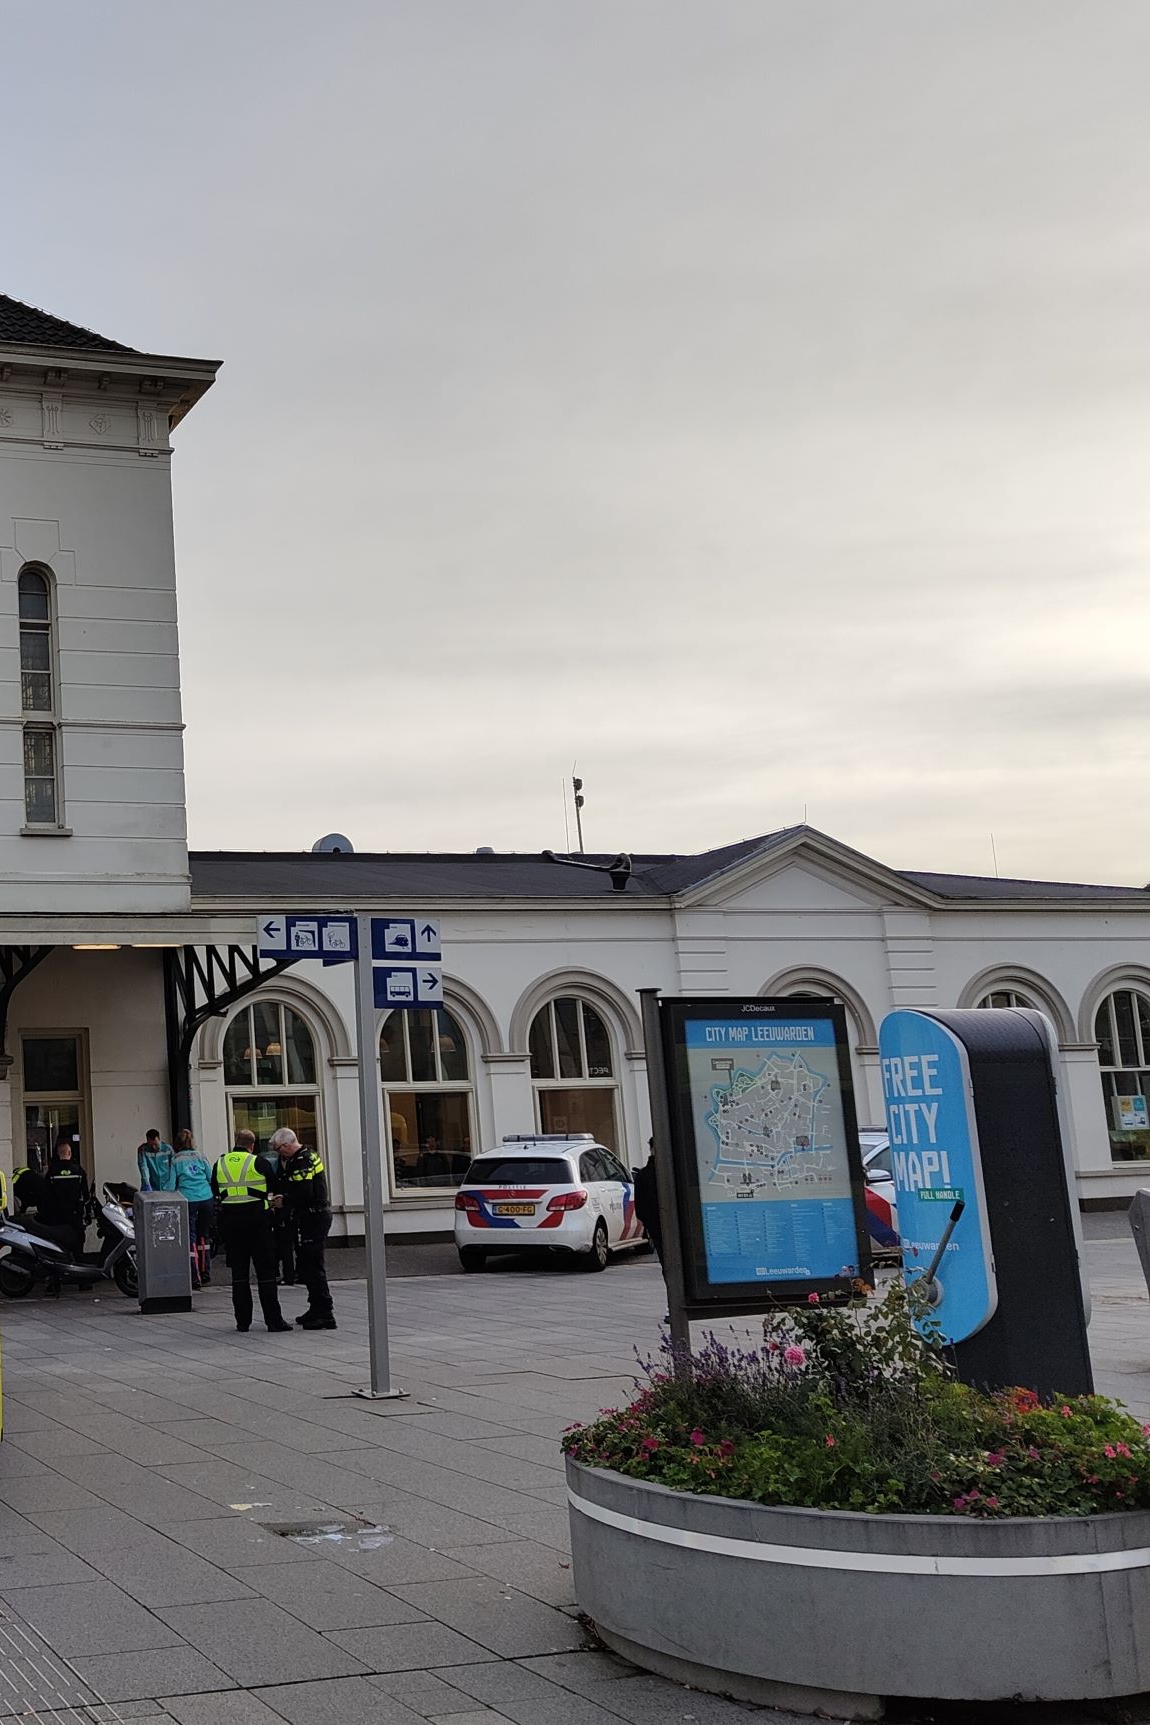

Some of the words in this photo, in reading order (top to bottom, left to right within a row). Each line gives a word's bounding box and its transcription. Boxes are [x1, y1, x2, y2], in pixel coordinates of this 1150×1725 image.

[741, 1004, 775, 1013] JCDecaux
[705, 1027, 726, 1042] CITY
[728, 1026, 749, 1042] MAP
[751, 1026, 815, 1042] LEEUWARDEN
[881, 1054, 943, 1098] FREE
[889, 1102, 939, 1145] CITY
[893, 1150, 951, 1192] MAP!
[920, 1190, 935, 1200] PULL
[935, 1190, 961, 1200] HANDLE
